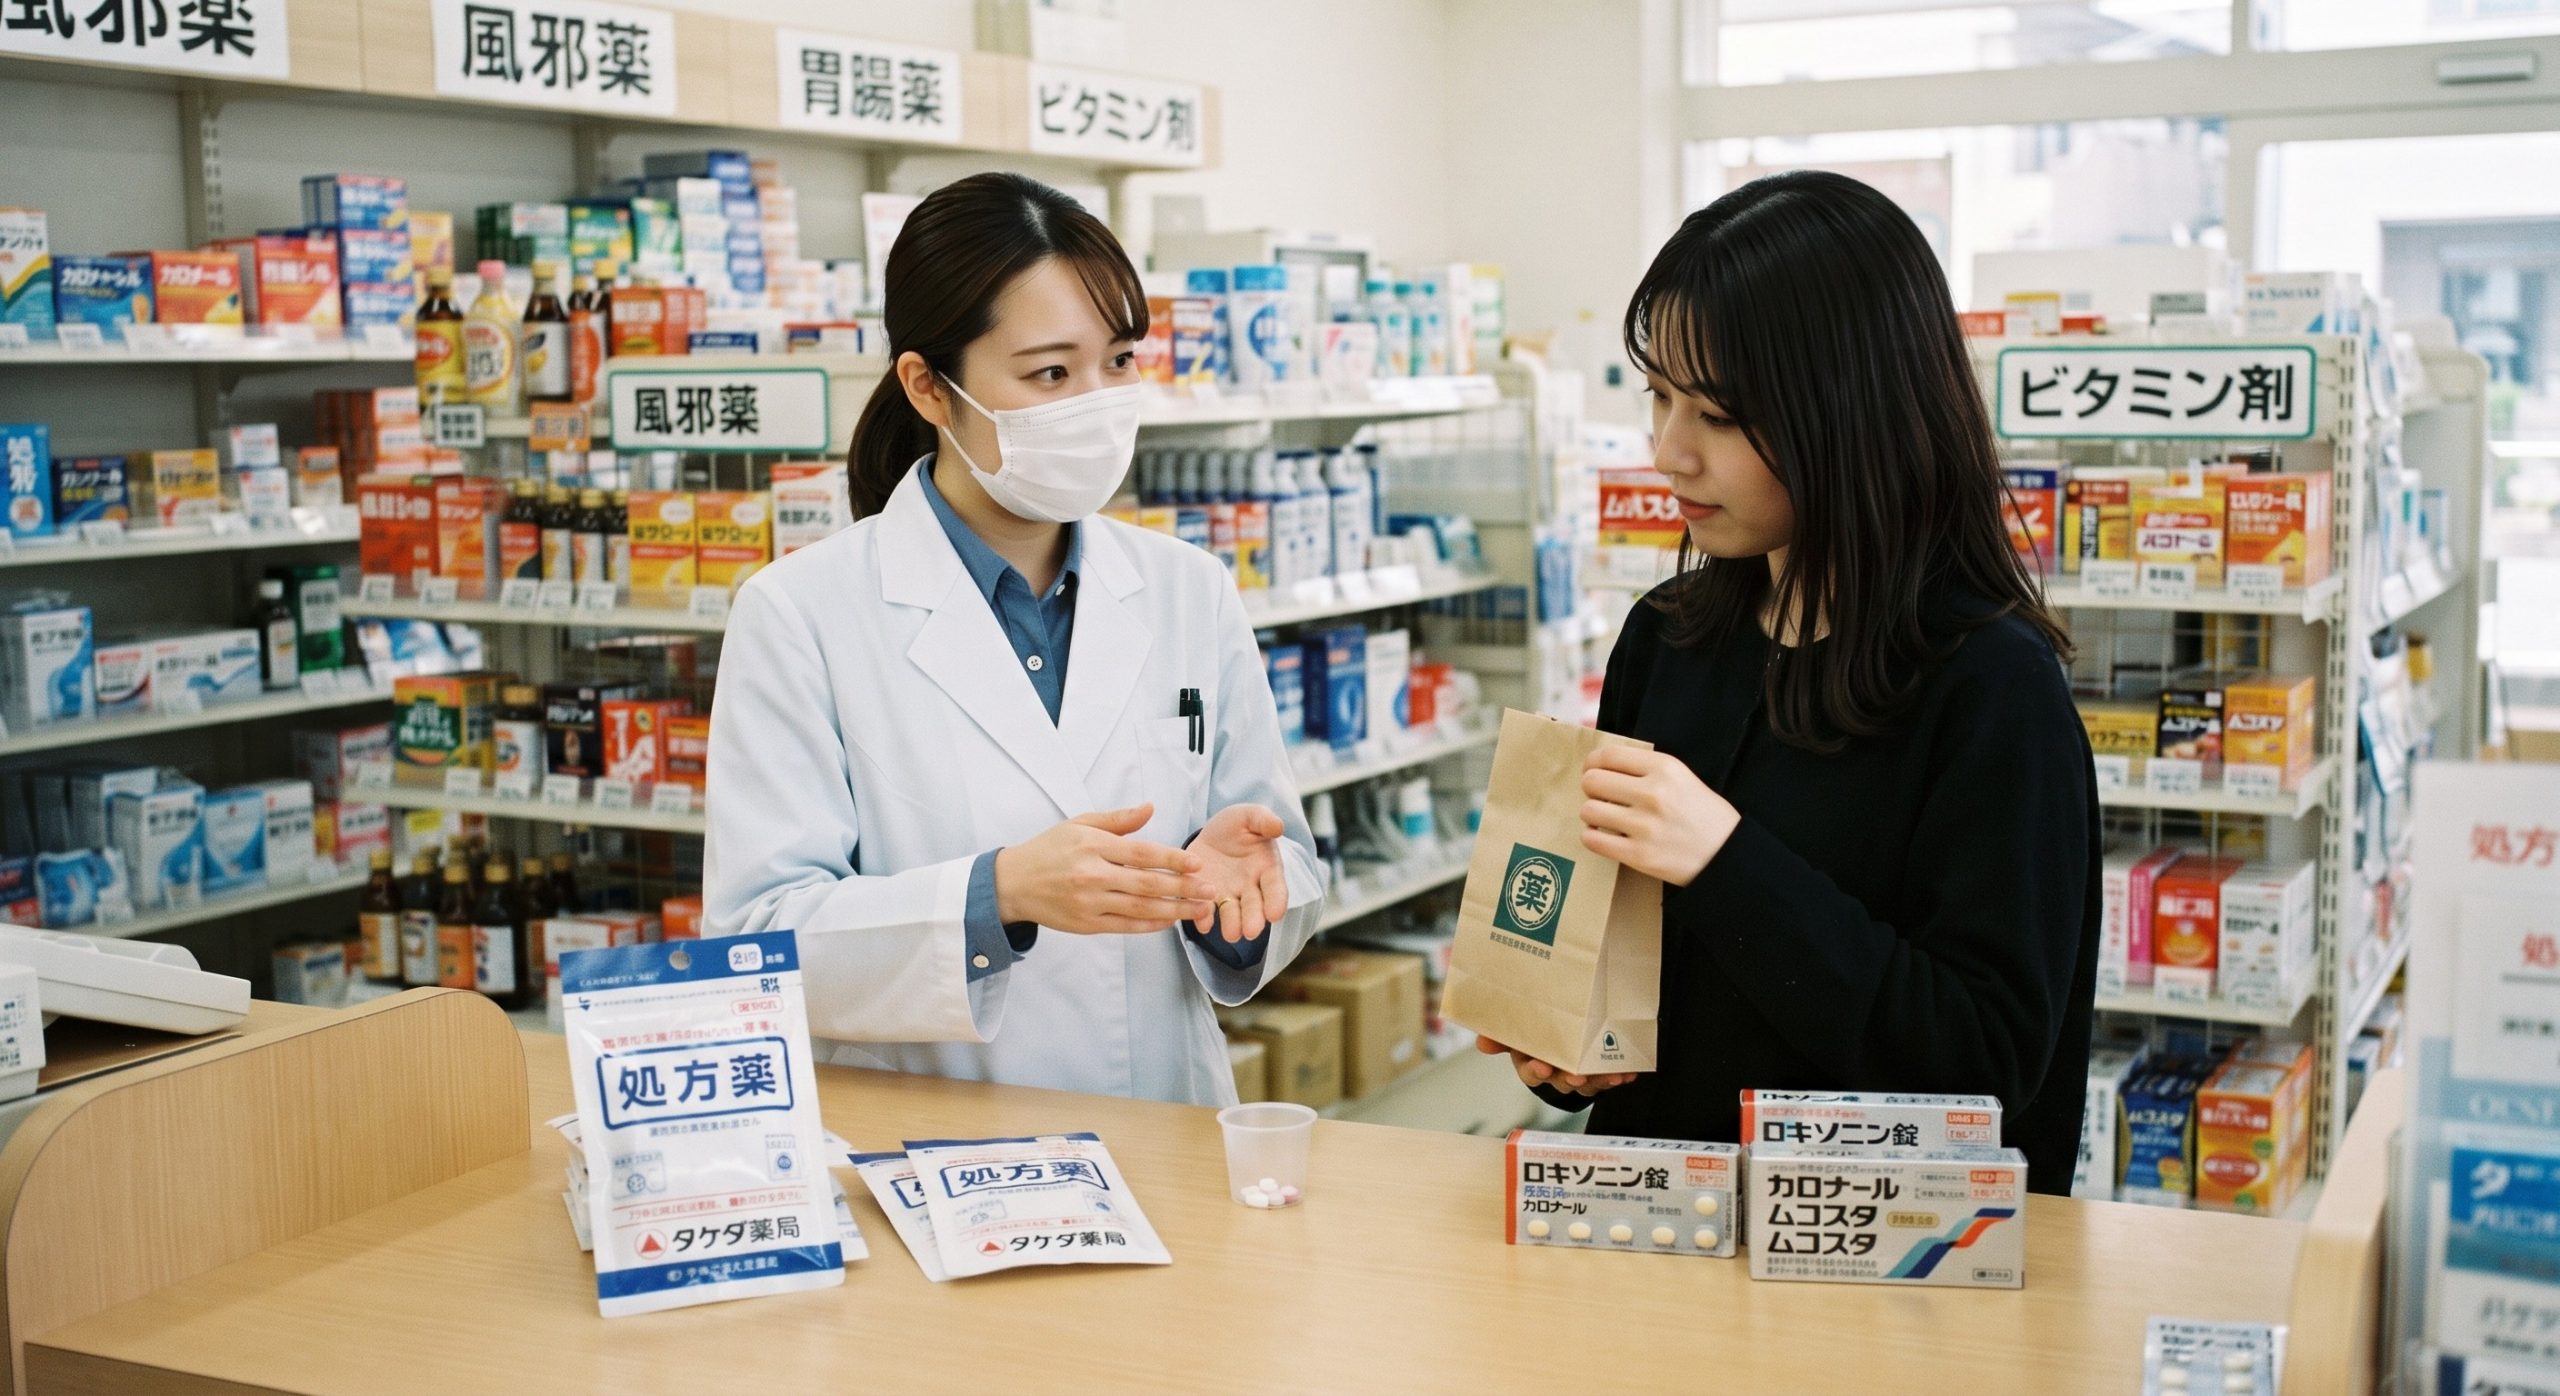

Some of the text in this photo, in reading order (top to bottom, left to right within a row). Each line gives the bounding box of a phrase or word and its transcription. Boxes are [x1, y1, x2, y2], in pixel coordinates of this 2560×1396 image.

[461, 3, 652, 96] 風邪薬
[800, 47, 943, 125] 胃腸薬
[1038, 82, 1195, 153] ビタミン剤
[2020, 364, 2294, 422] ビタミン剤
[634, 385, 760, 436] 風邪薬
[1516, 870, 1552, 915] 薬
[616, 1051, 780, 1111] 処方薬
[1762, 1121, 1920, 1148] ロキソニン錠
[958, 1160, 1095, 1189] 処方薬
[1523, 1161, 1669, 1191] ロキソニン錠
[1767, 1174, 1901, 1201] カロナール
[1522, 1199, 1588, 1216] カロナール
[1768, 1203, 1879, 1228] ムコスタ
[672, 1215, 801, 1252] タケダ薬局
[1010, 1230, 1127, 1252] タケダ薬局
[1767, 1232, 1878, 1257] ムコスタ
